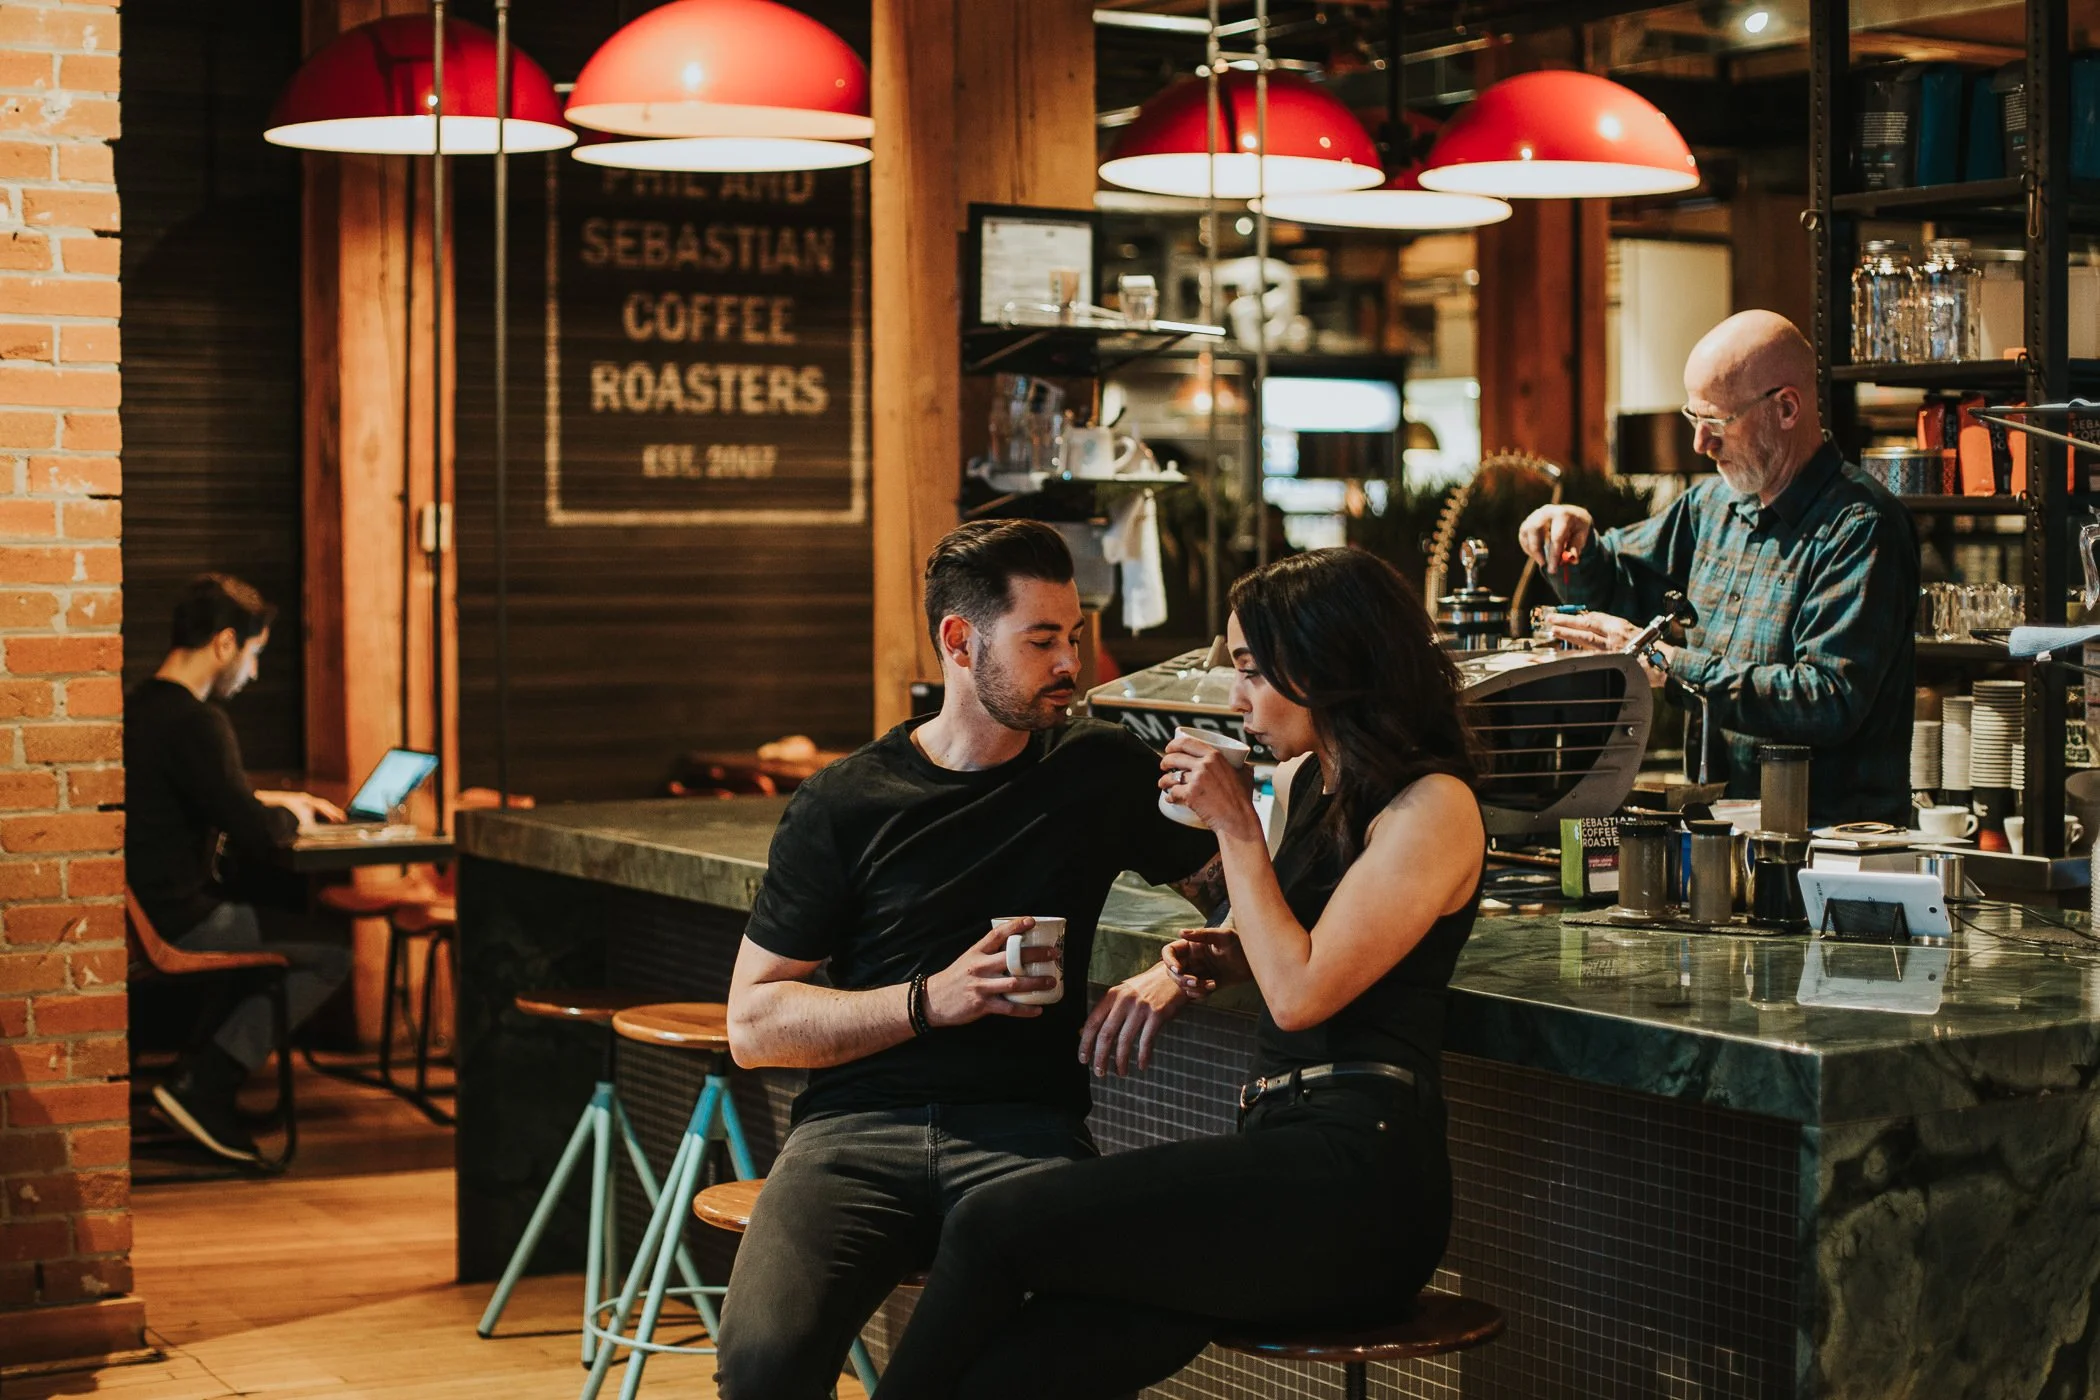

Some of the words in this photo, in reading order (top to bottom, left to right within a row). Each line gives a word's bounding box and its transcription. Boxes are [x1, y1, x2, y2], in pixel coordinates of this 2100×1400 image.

[582, 217, 834, 271] SEBASTIAN
[622, 292, 798, 346] COFFEE
[590, 361, 829, 415] ROASTERS
[1582, 826, 1619, 838] COFFEE
[1582, 837, 1620, 848] ROASTE
